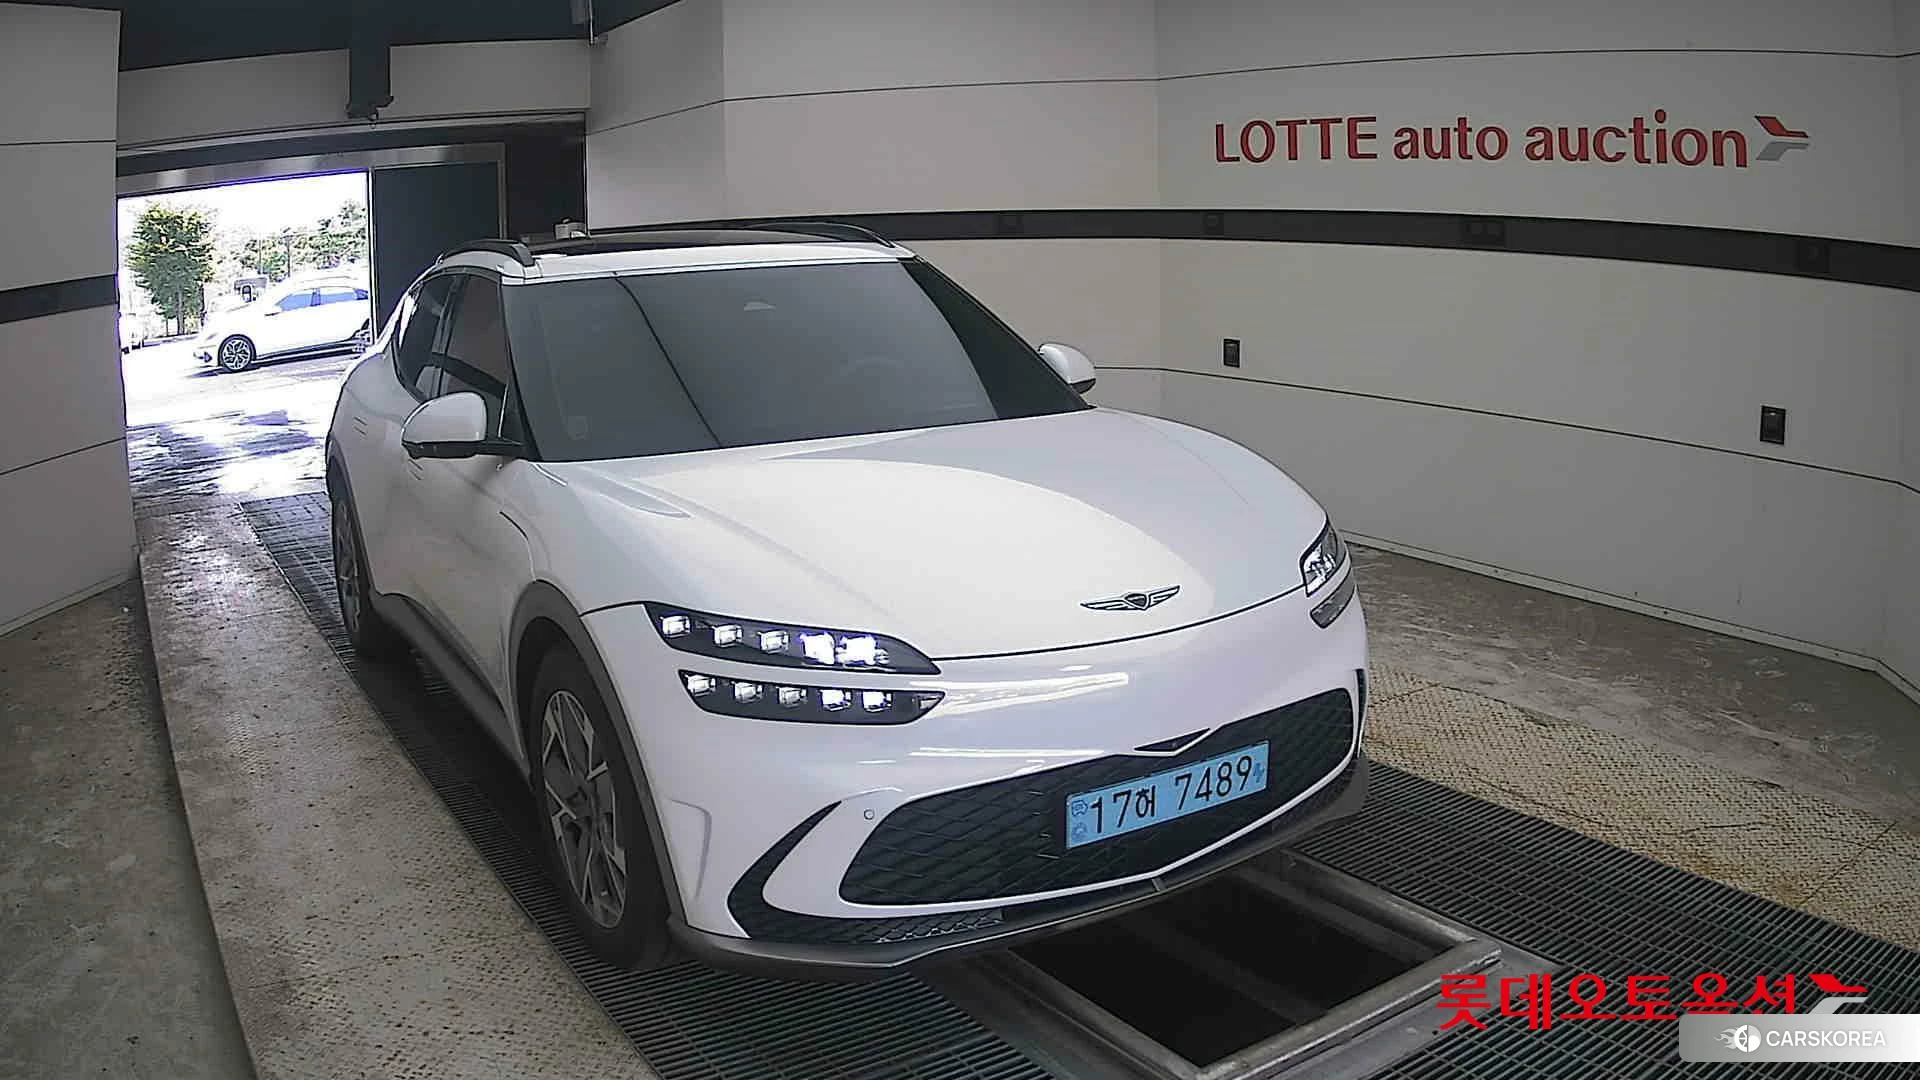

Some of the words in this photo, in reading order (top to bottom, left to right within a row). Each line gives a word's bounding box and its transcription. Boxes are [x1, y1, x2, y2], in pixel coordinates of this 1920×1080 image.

[1215, 116, 1377, 163] LOTTE
[1392, 117, 1509, 161] auto
[1525, 109, 1748, 168] auction
[1090, 785, 1157, 833] 17허
[1175, 756, 1253, 811] 7489
